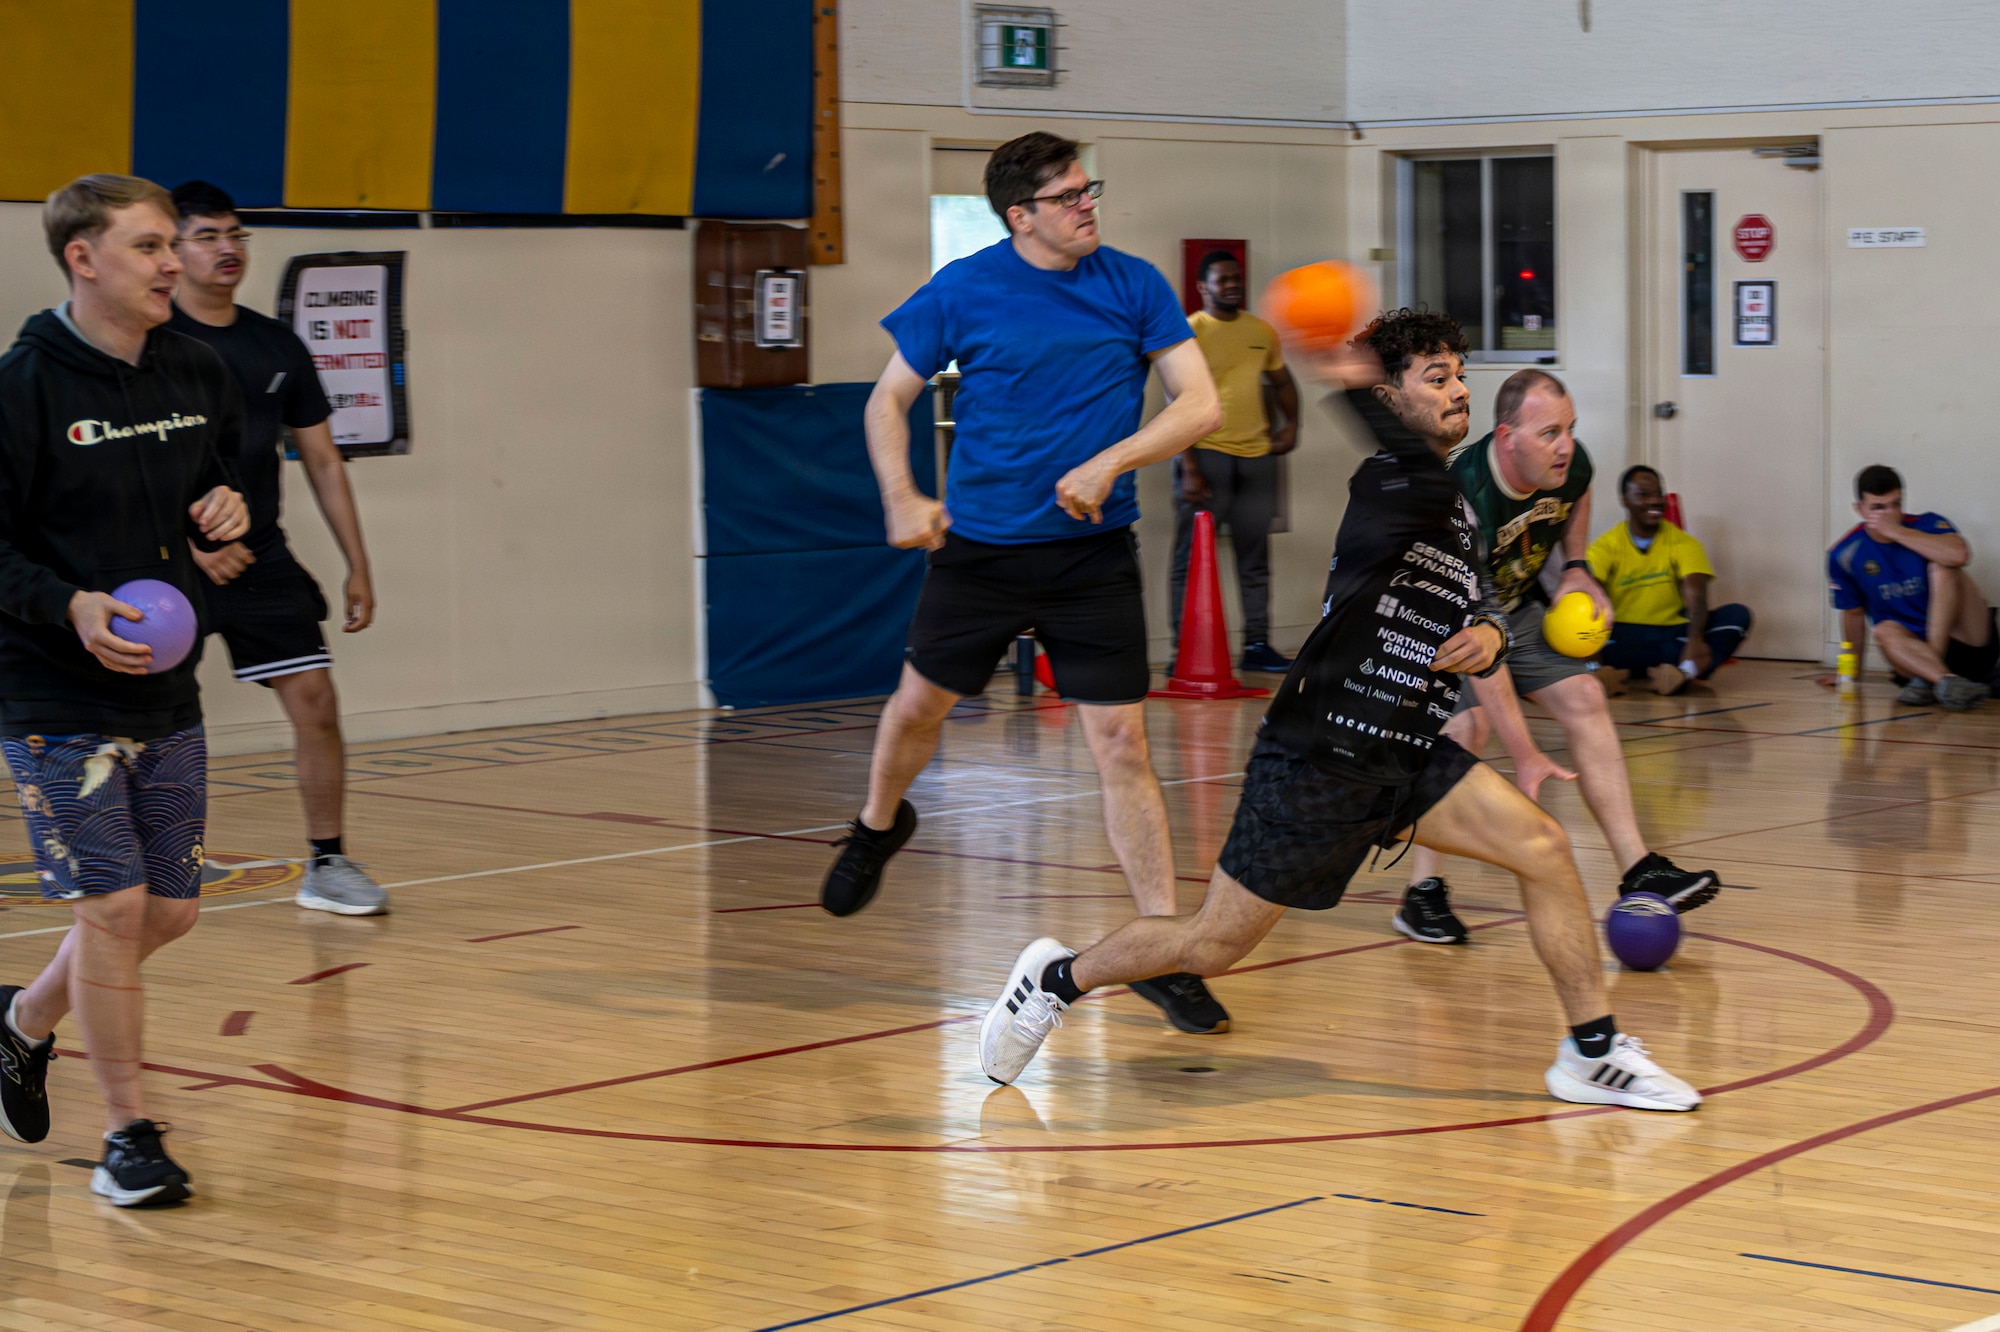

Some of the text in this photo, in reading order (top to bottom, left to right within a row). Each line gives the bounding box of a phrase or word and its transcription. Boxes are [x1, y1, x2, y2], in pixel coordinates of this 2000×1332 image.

[304, 290, 378, 308] CLIMBING
[309, 319, 373, 340] IS NOT
[311, 352, 387, 371] ERMITTED
[67, 412, 207, 446] Champion
[1397, 605, 1451, 638] Microsoft
